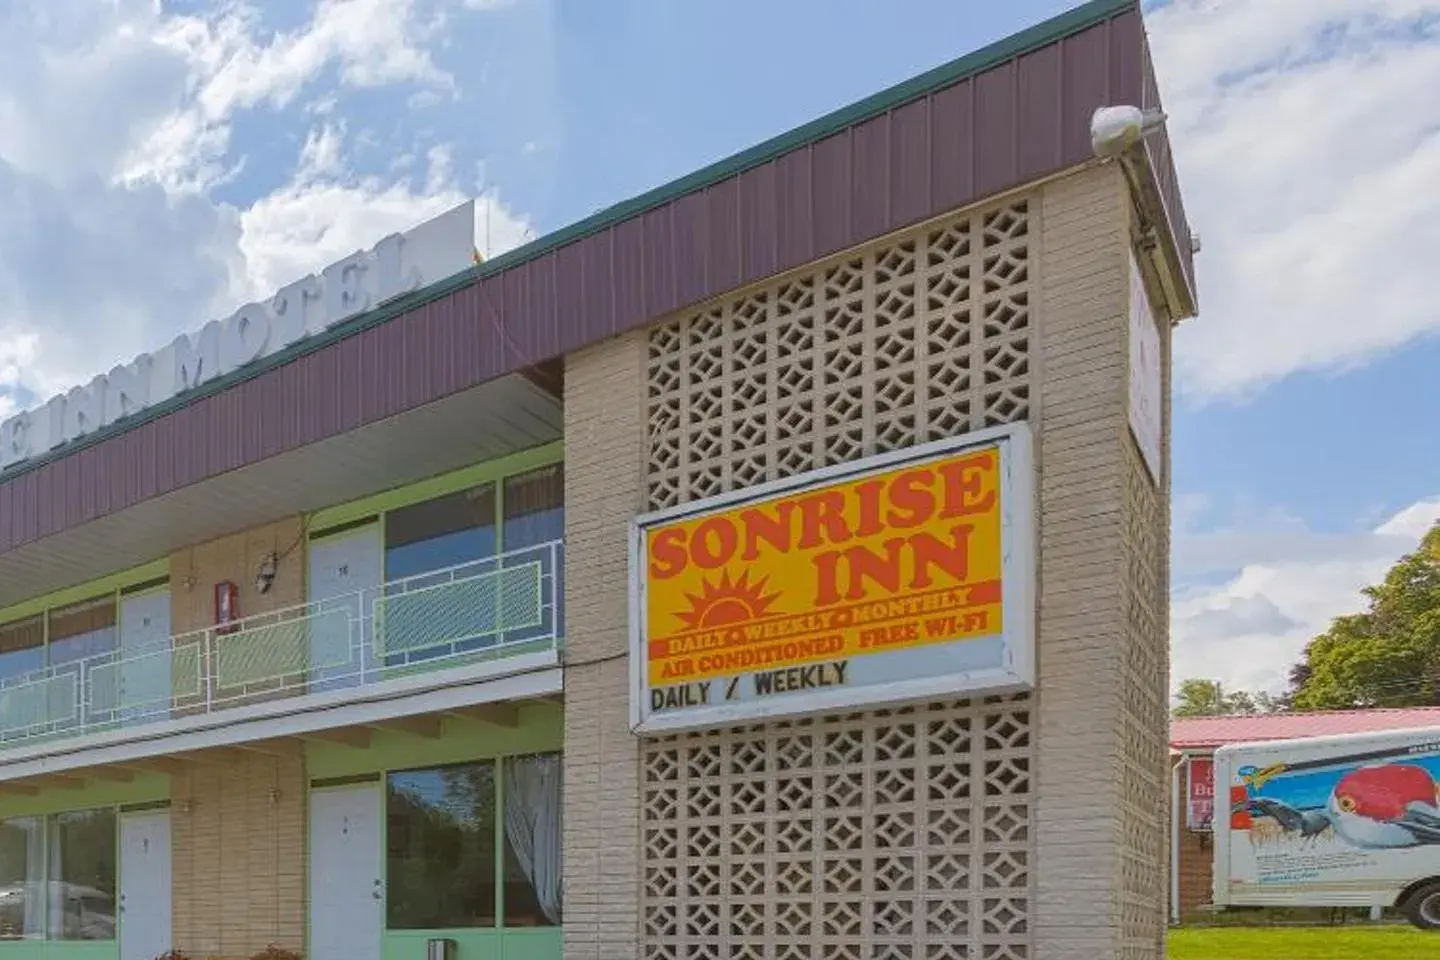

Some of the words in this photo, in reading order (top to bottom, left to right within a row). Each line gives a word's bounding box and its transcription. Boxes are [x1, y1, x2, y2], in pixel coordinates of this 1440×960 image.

[48, 353, 152, 451] INN
[154, 232, 424, 398] MOTEL
[650, 453, 998, 580] SONRISE
[811, 523, 975, 608] INN
[662, 659, 696, 679] AIR
[698, 635, 845, 672] CONDITIONED
[858, 623, 920, 648] FREE
[923, 611, 989, 638] WI-FI
[669, 631, 728, 655] DAILY
[742, 611, 836, 640] WEEKLY
[851, 587, 973, 624] MONTHLY
[651, 681, 711, 712] DAILY
[755, 660, 849, 696] WEEKLY
